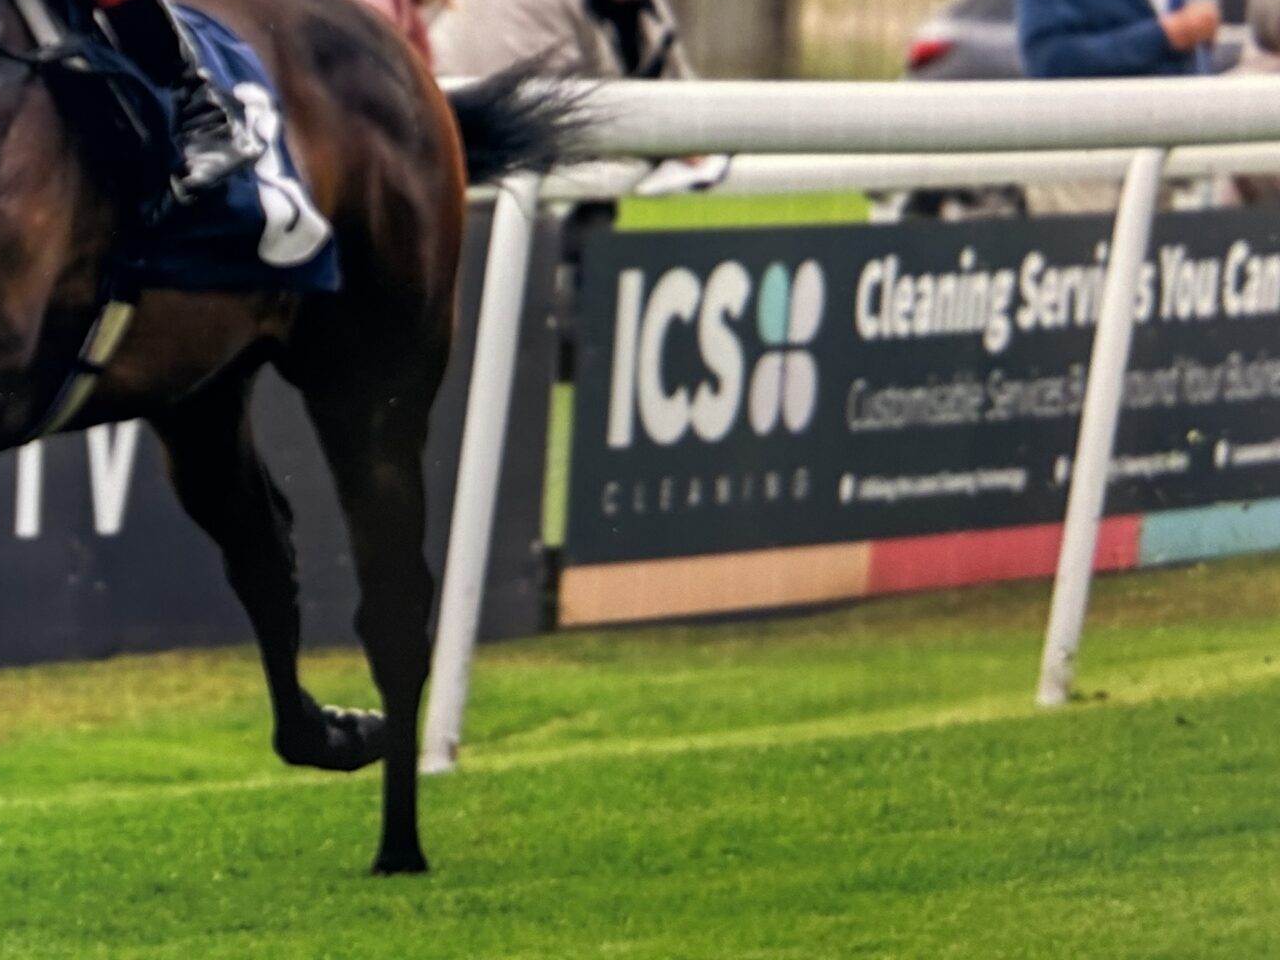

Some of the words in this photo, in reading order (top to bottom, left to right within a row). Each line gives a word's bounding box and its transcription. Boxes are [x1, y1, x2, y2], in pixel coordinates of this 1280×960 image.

[608, 261, 751, 447] ICS
[855, 246, 1015, 354] Cleaning
[1017, 242, 1154, 329] Servis
[1159, 244, 1218, 321] You
[1223, 240, 1280, 318] Can
